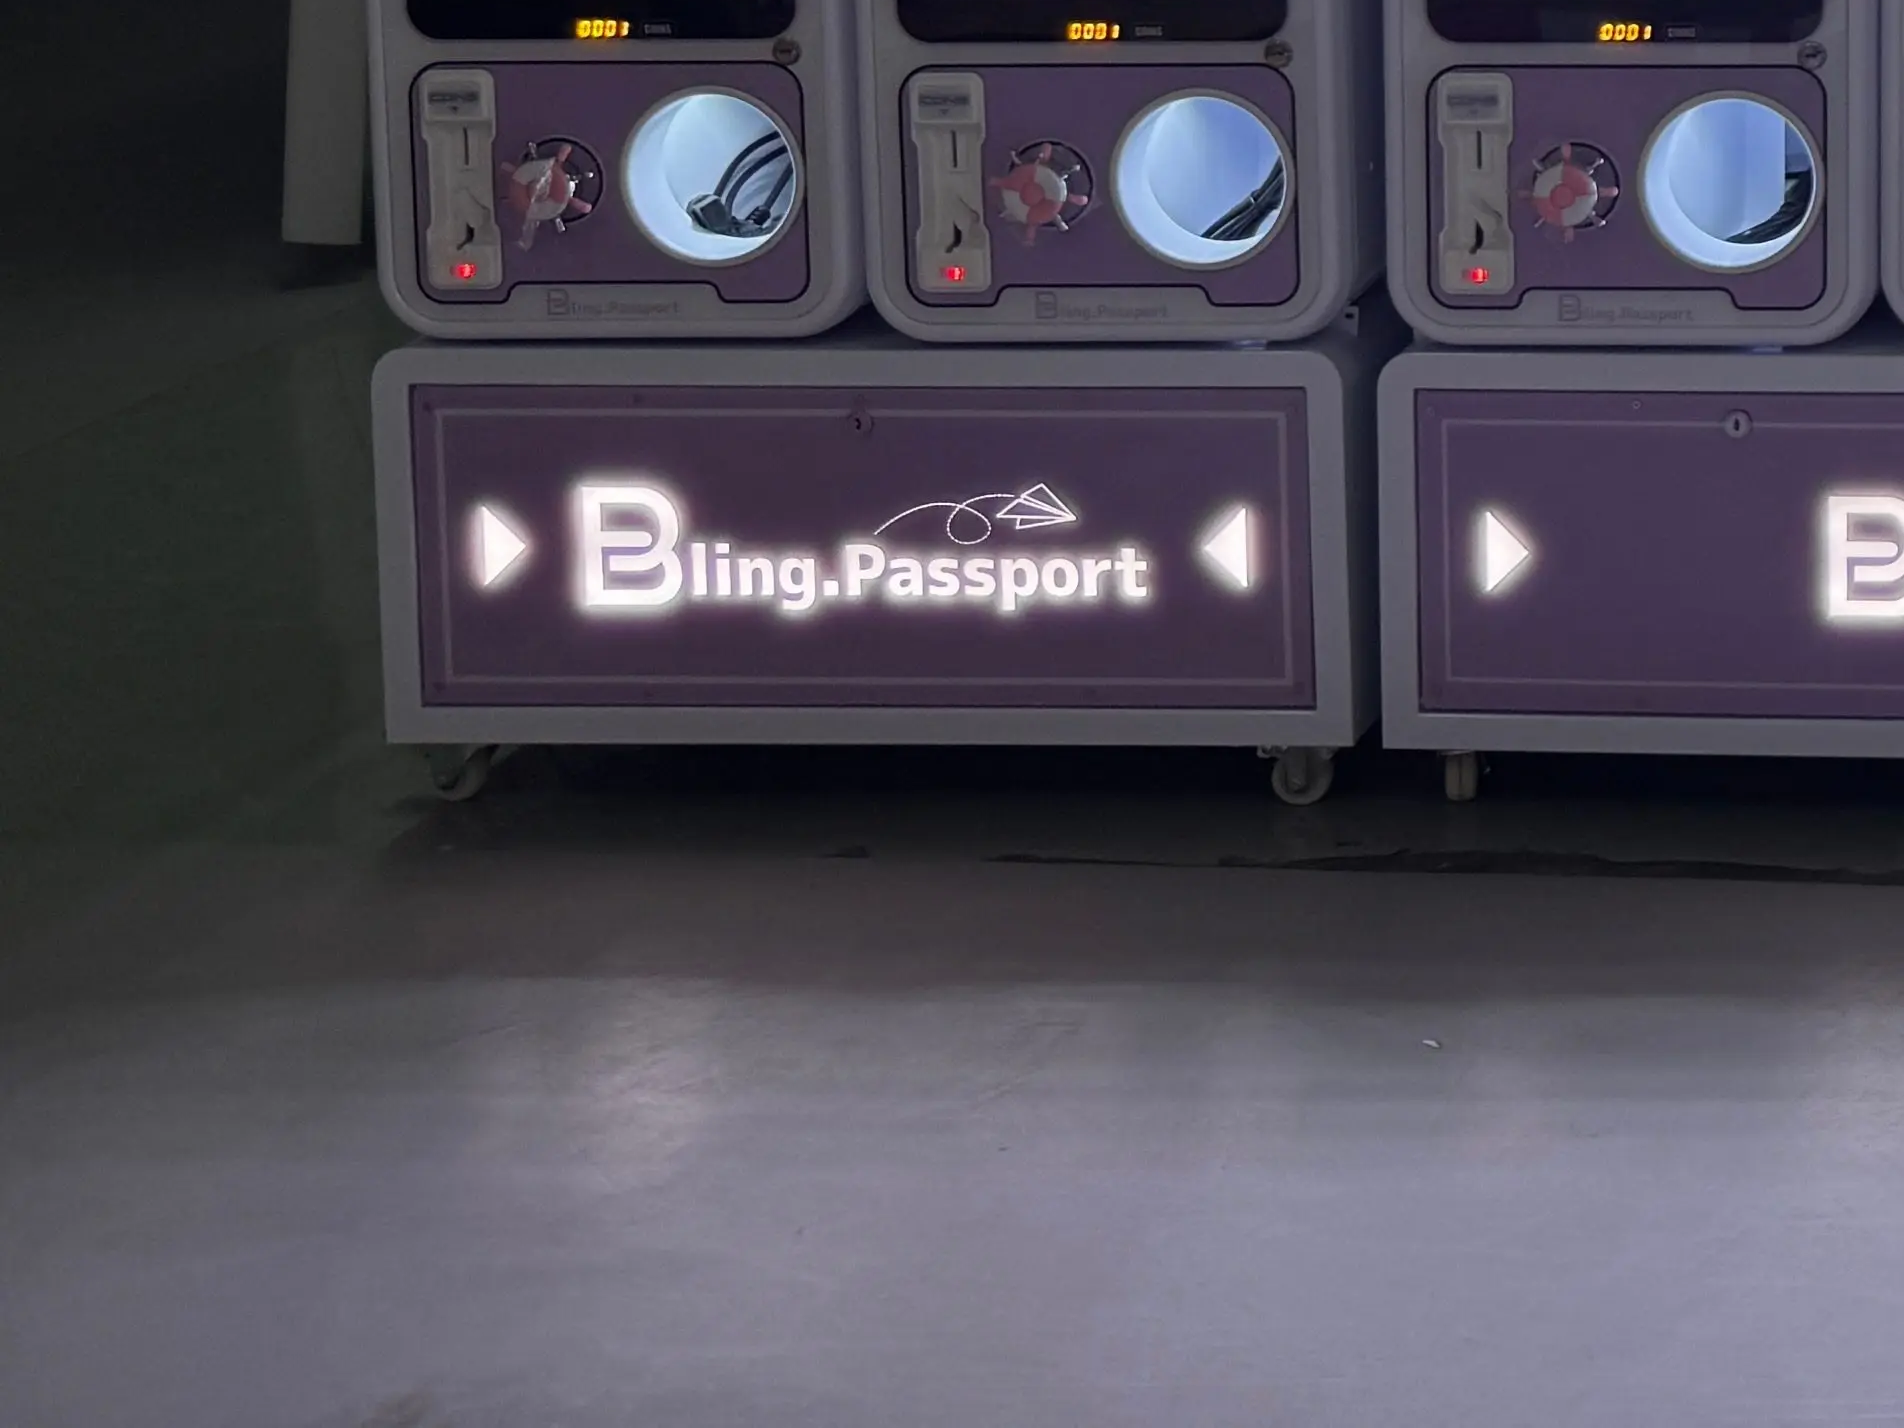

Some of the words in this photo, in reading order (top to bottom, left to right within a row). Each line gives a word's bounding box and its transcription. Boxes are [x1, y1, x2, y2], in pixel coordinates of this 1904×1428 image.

[1068, 23, 1119, 40] 0001
[1600, 23, 1651, 41] 0001
[579, 485, 1149, 612] Bling.Passport
